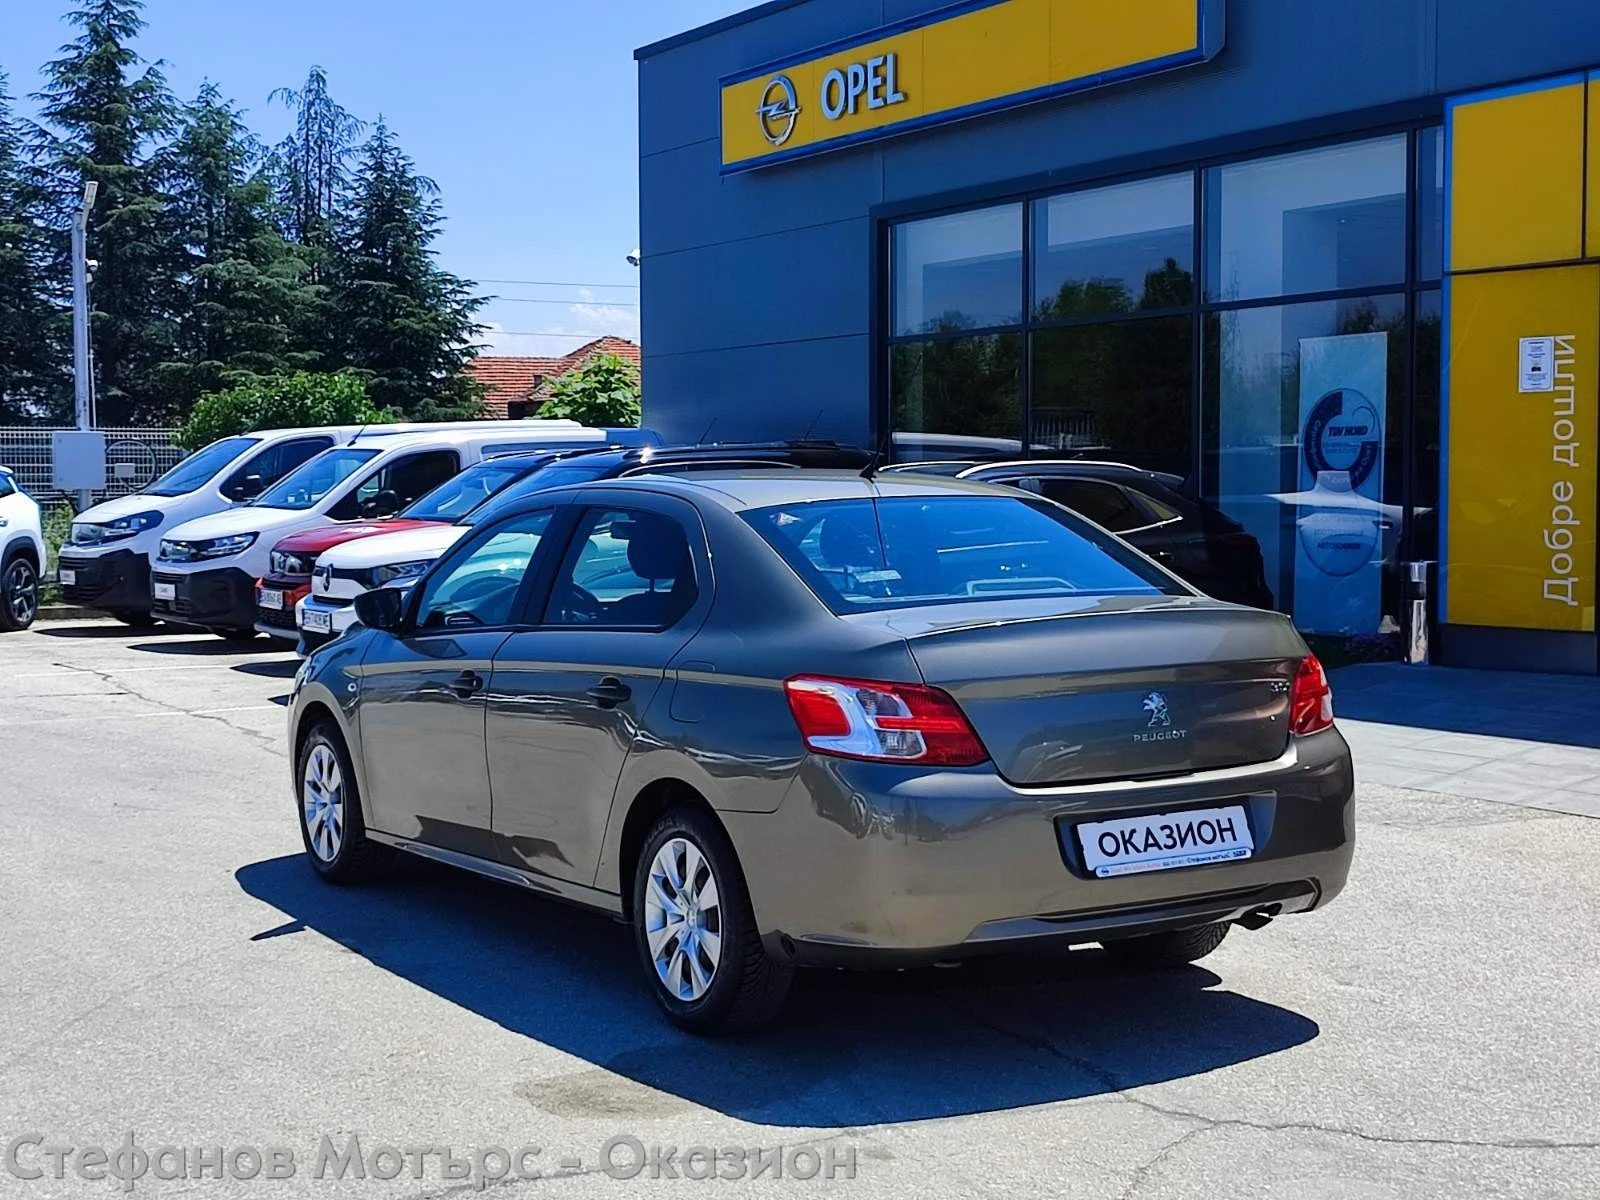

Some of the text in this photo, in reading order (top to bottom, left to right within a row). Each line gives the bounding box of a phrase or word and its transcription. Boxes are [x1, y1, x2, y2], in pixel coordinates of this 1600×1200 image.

[820, 53, 906, 120] OPEL
[1345, 425, 1369, 437] NORD
[1543, 335, 1580, 605] Добре дошли
[1133, 729, 1187, 743] PEUGEOT
[1098, 817, 1238, 858] ОКАЗИОН
